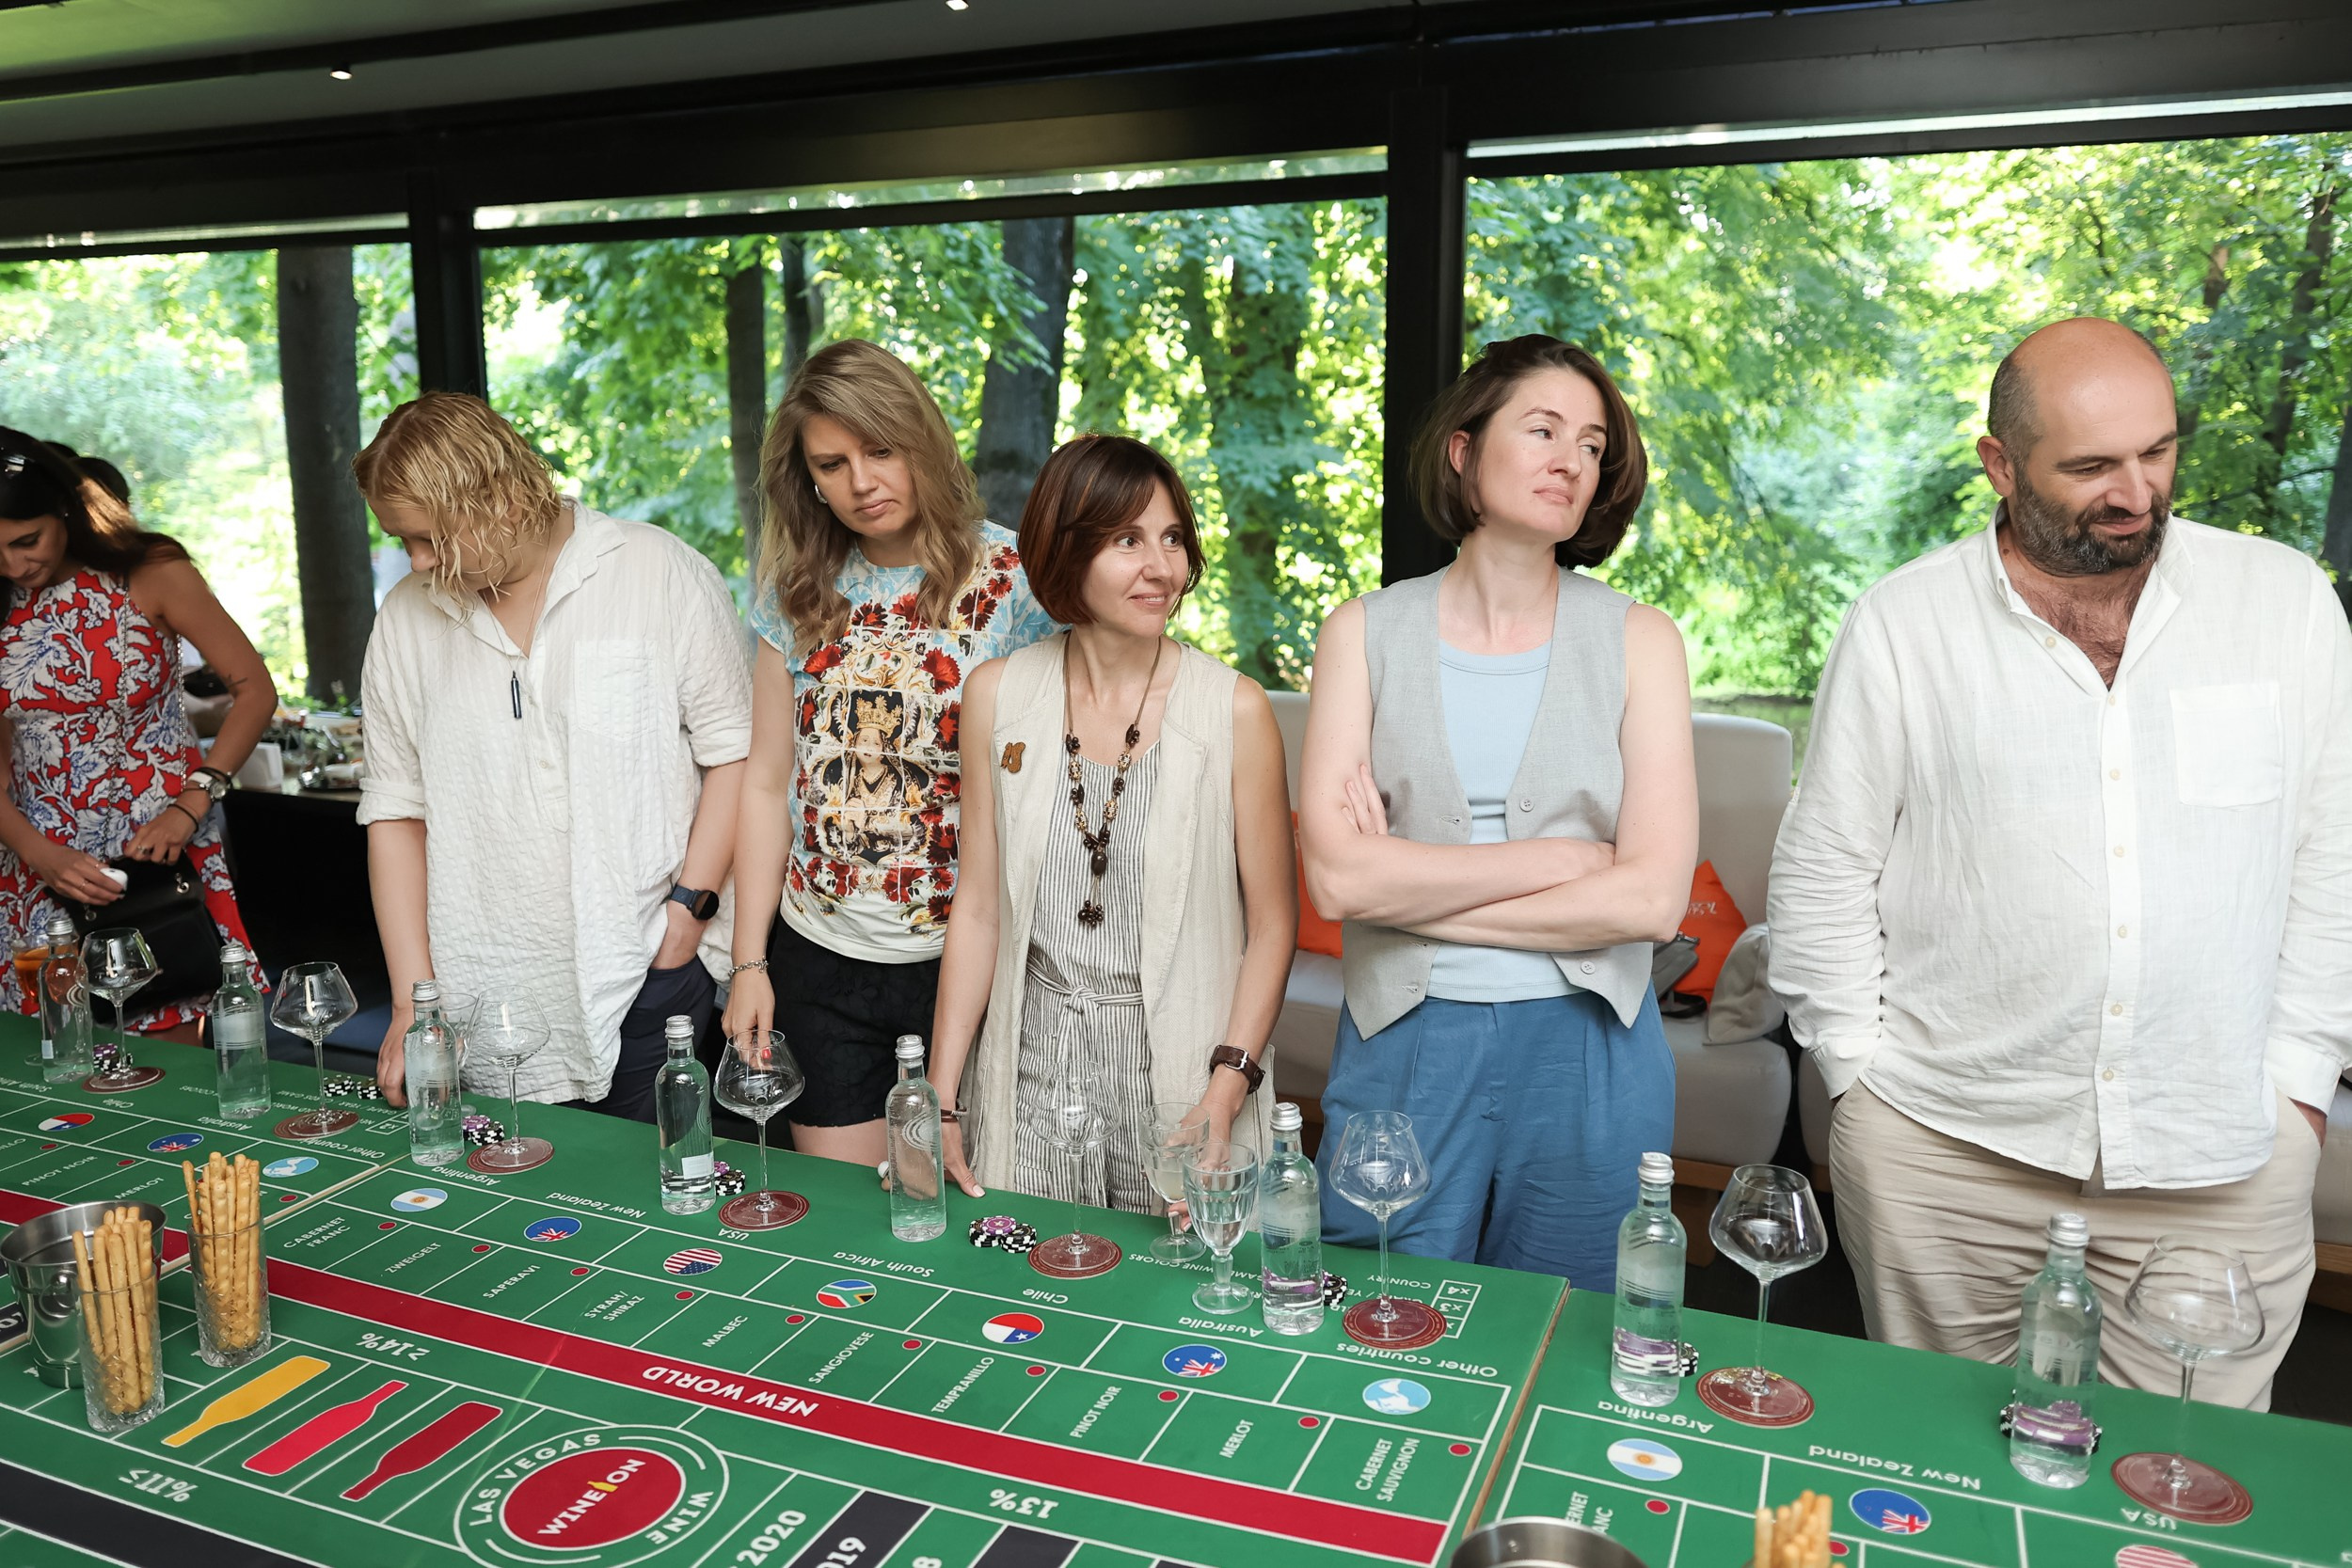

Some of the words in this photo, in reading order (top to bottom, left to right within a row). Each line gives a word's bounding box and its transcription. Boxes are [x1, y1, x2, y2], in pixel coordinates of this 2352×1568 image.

[197, 1116, 253, 1132] Australia
[347, 1147, 386, 1160] Other
[114, 1177, 166, 1200] MERLOT
[431, 1165, 501, 1187] Argentina
[546, 1190, 613, 1212] Zealand
[614, 1205, 647, 1220] New
[283, 1216, 347, 1250] CABERNET
[306, 1225, 352, 1249] FRANC
[717, 1227, 751, 1242] USA
[384, 1242, 442, 1275] ZWEIGELT
[832, 1250, 890, 1269] Africa
[889, 1260, 936, 1278] South
[482, 1263, 541, 1300] SAPERAVI
[1446, 1285, 1473, 1296] x4
[584, 1290, 629, 1320] SYRAH/
[602, 1294, 645, 1323] SHIRAZ
[1022, 1288, 1070, 1306] Chile
[1438, 1302, 1464, 1314] x3
[701, 1314, 749, 1349] MALBEC
[1178, 1315, 1264, 1338] Australia
[807, 1331, 875, 1385] SANGIOVESE
[1336, 1341, 1433, 1366] countries
[1436, 1356, 1499, 1379] Other
[642, 1365, 747, 1402] WORLD
[930, 1355, 995, 1414] TEMPRANILLO
[745, 1386, 819, 1418] NEW
[1069, 1408, 1099, 1439] PINOT
[1094, 1386, 1122, 1414] NOIR
[1597, 1400, 1715, 1434] Argentina
[1218, 1418, 1255, 1460] MERLOT
[1355, 1437, 1394, 1492] CABERNET
[1376, 1437, 1422, 1503] SAUVIGNON
[1808, 1444, 1915, 1477] Zealand
[469, 1486, 501, 1528] LAS
[495, 1433, 602, 1483] VEGAS
[1922, 1469, 1982, 1491] New
[645, 1491, 714, 1544] WINE
[989, 1488, 1059, 1519] 13%
[1565, 1491, 1589, 1525] ERNET
[1592, 1506, 1613, 1535] ANC
[2120, 1506, 2179, 1531] USA
[737, 1510, 806, 1566] 2020
